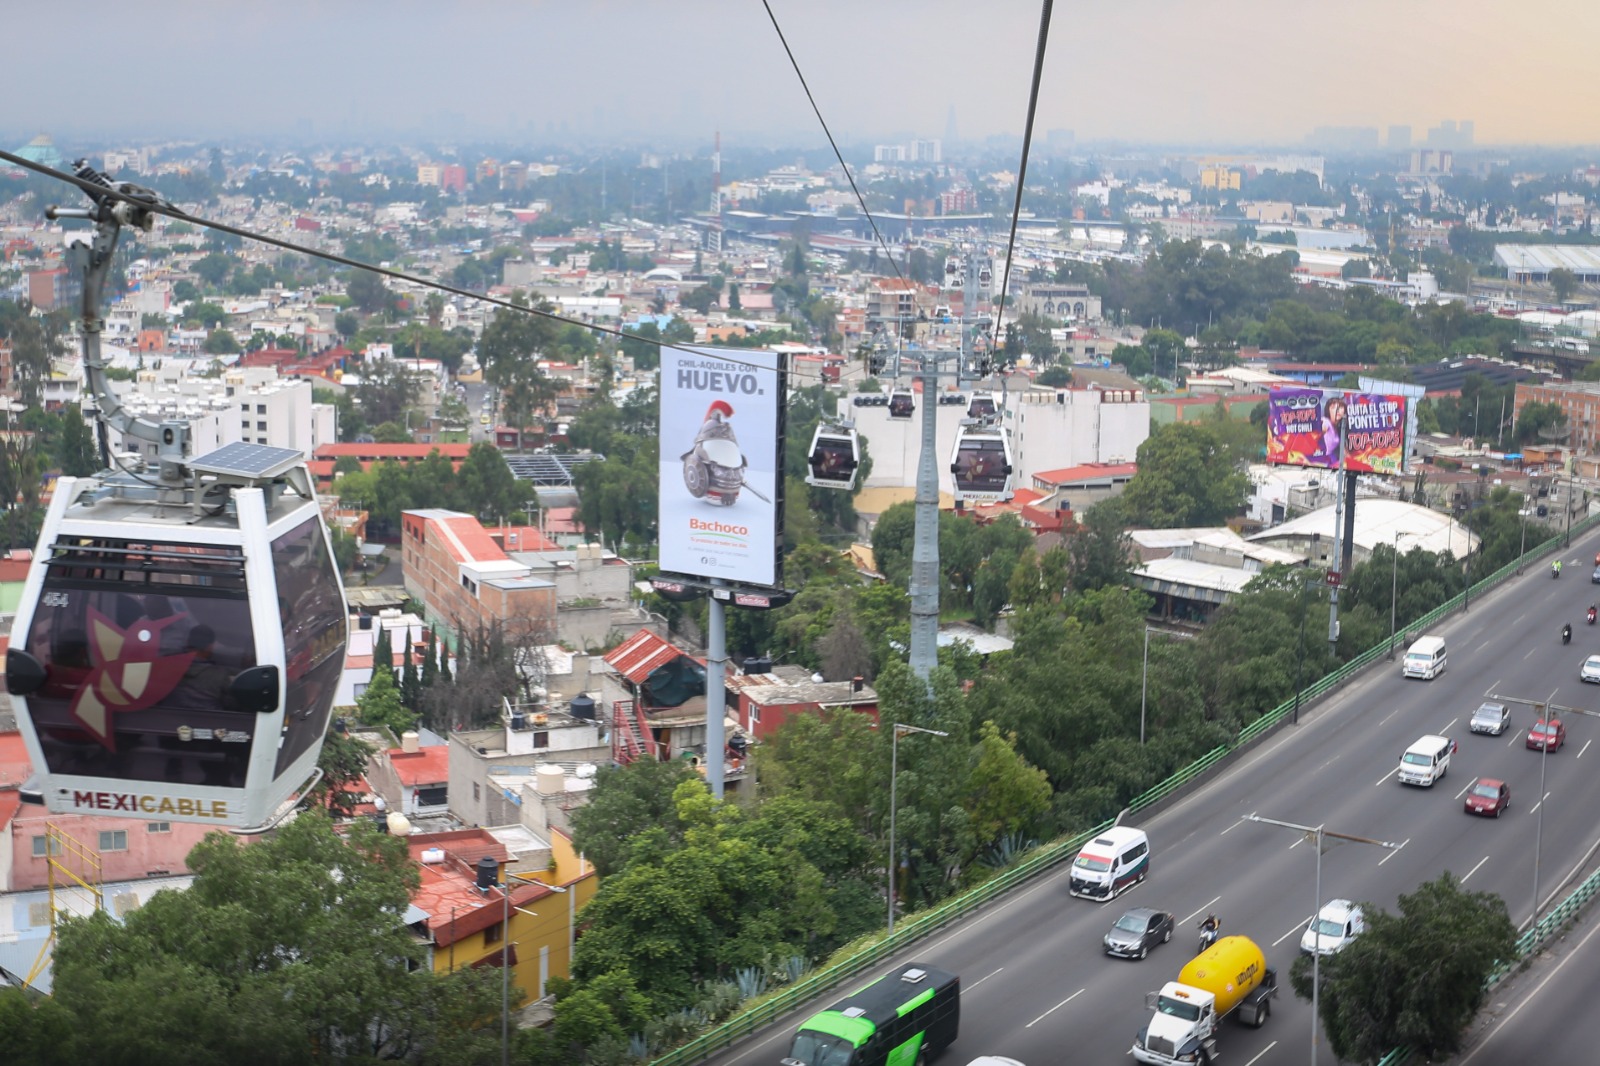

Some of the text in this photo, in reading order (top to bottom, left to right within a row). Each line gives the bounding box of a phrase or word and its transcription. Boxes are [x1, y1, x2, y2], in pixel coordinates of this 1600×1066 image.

[678, 359, 758, 373] CHIL-AQUILES CON
[677, 369, 764, 395] HUEVO.
[1347, 401, 1398, 416] QUITA EL STOP
[1348, 413, 1399, 430] PONTE TOP
[690, 518, 748, 535] Bachoco
[73, 790, 228, 818] MEXICABLE
